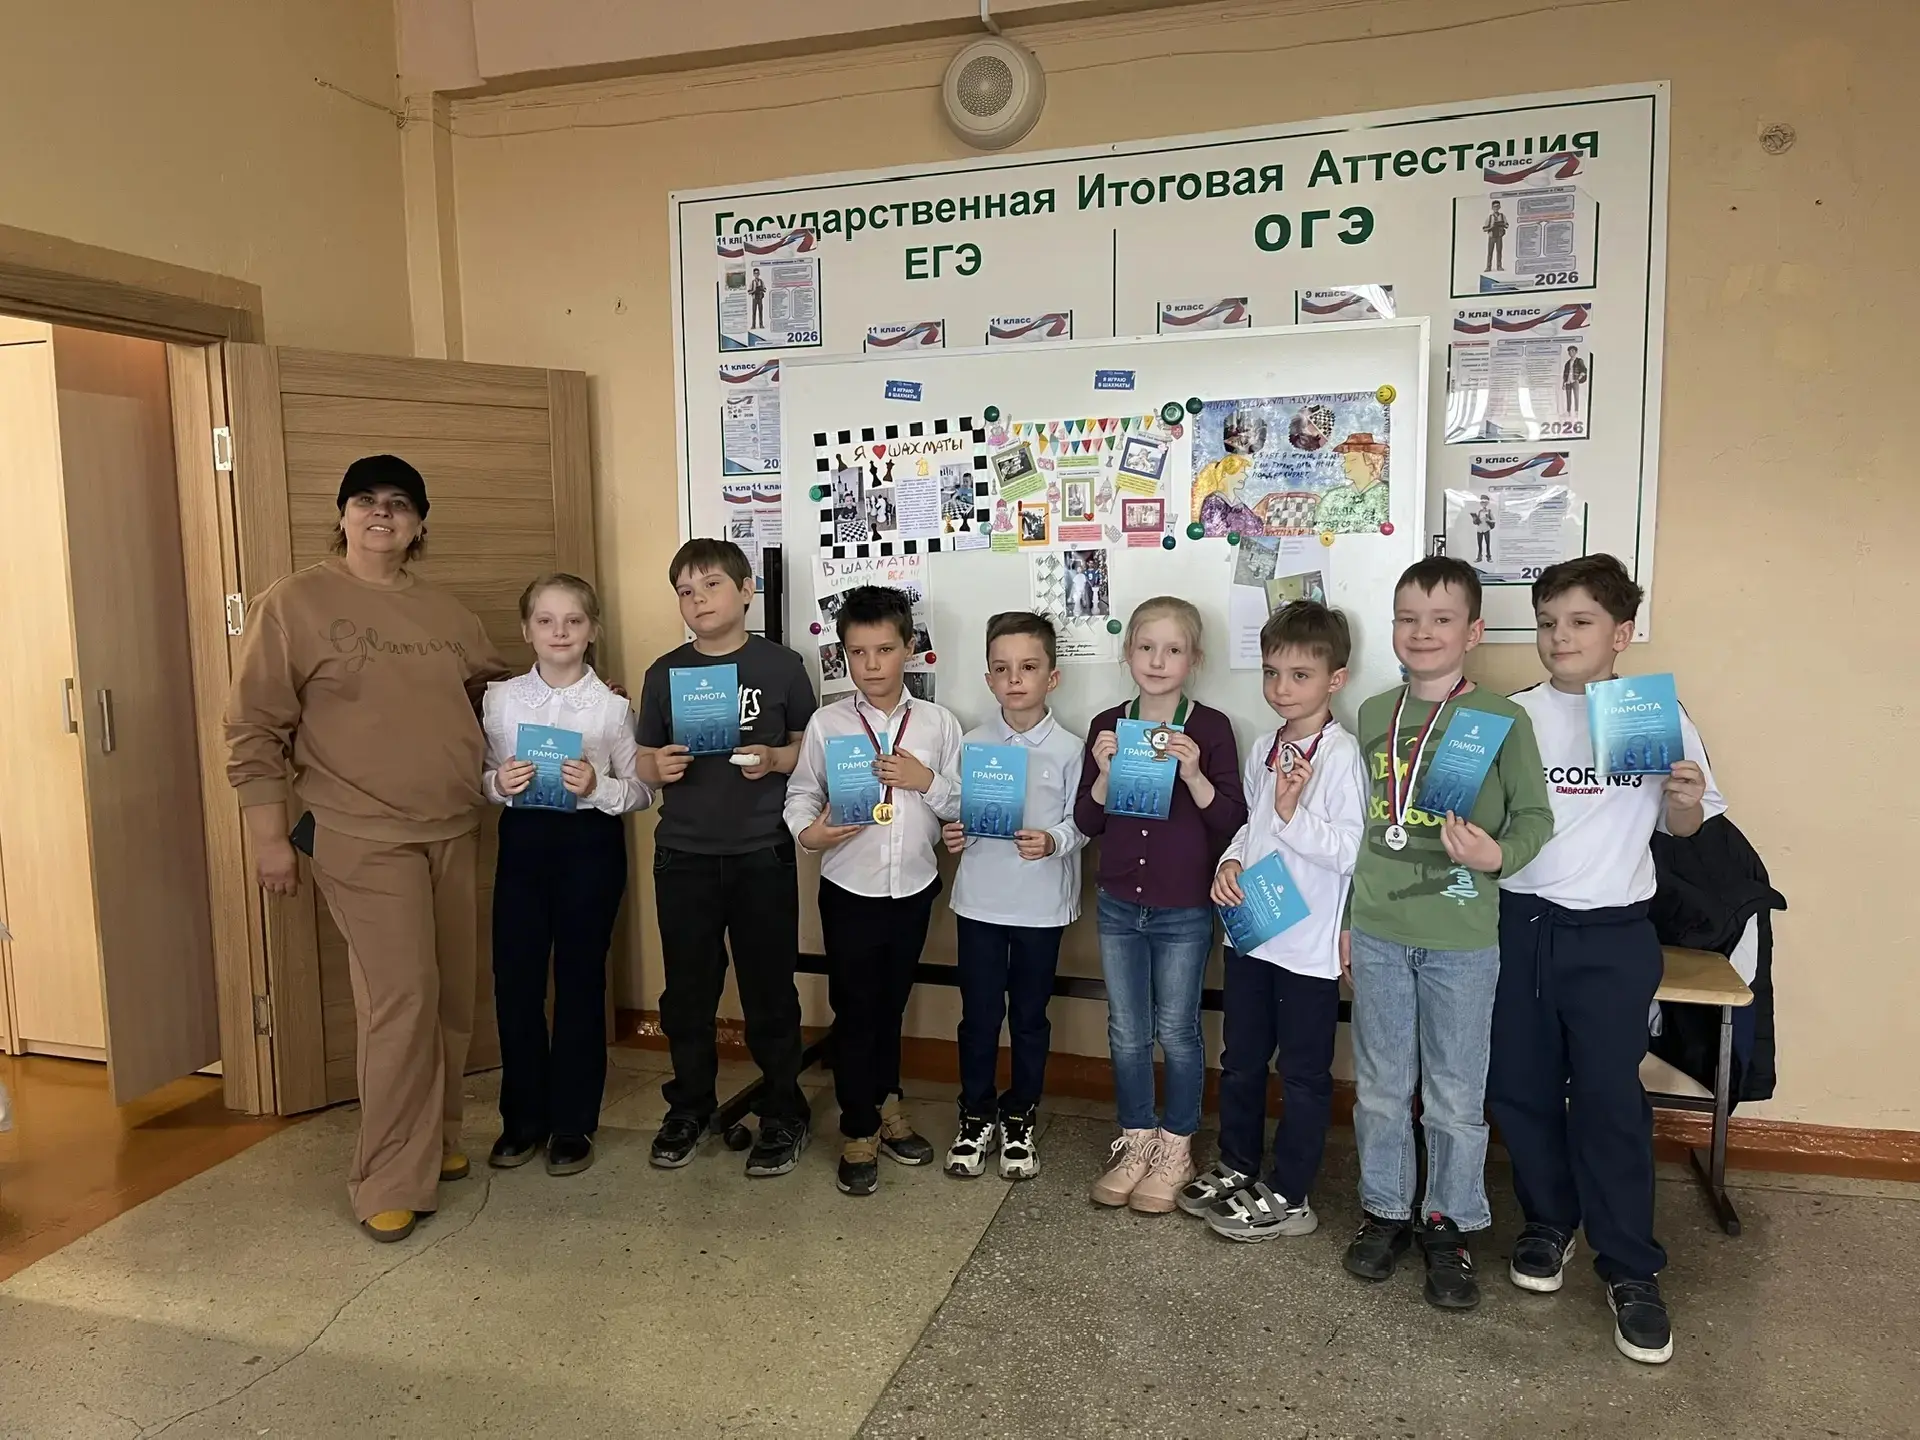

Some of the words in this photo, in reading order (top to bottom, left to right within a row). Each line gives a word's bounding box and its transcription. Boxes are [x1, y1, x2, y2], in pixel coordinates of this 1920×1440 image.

[1488, 159, 1496, 168] 9
[1498, 157, 1533, 167] класс
[1077, 164, 1285, 210] Итоговая
[1254, 206, 1375, 252] ОГЭ
[716, 236, 727, 246] 11
[744, 233, 755, 242] 11
[756, 232, 782, 240] класс
[905, 242, 983, 280] ЕГЭ
[1535, 271, 1579, 286] 2026
[1305, 290, 1312, 298] 9
[1316, 288, 1347, 298] класс
[1165, 304, 1173, 312] 9
[1174, 303, 1205, 311] класс
[1496, 308, 1503, 317] 9
[1506, 308, 1541, 317] класс
[1458, 310, 1466, 319] 9
[990, 317, 1002, 326] 11
[1002, 315, 1031, 324] класс
[867, 326, 878, 335] 11
[880, 324, 906, 333] класс
[787, 331, 819, 343] 2026
[1540, 421, 1584, 435] 2026
[854, 445, 867, 462] Я
[888, 438, 963, 457] ШАХМАТЫ
[764, 458, 779, 470] 20
[1475, 456, 1483, 465] 9
[1485, 455, 1520, 464] класс
[822, 561, 835, 577] В
[1521, 566, 1546, 579] 20
[683, 692, 727, 702] ГРАМОТА
[1124, 747, 1157, 758] ГРАМО
[1448, 739, 1486, 755] ГРАМОТА
[527, 749, 569, 760] ГРАМОТА
[972, 770, 1014, 782] ГРАМОТА
[1256, 874, 1282, 920] ГРАМОТА
